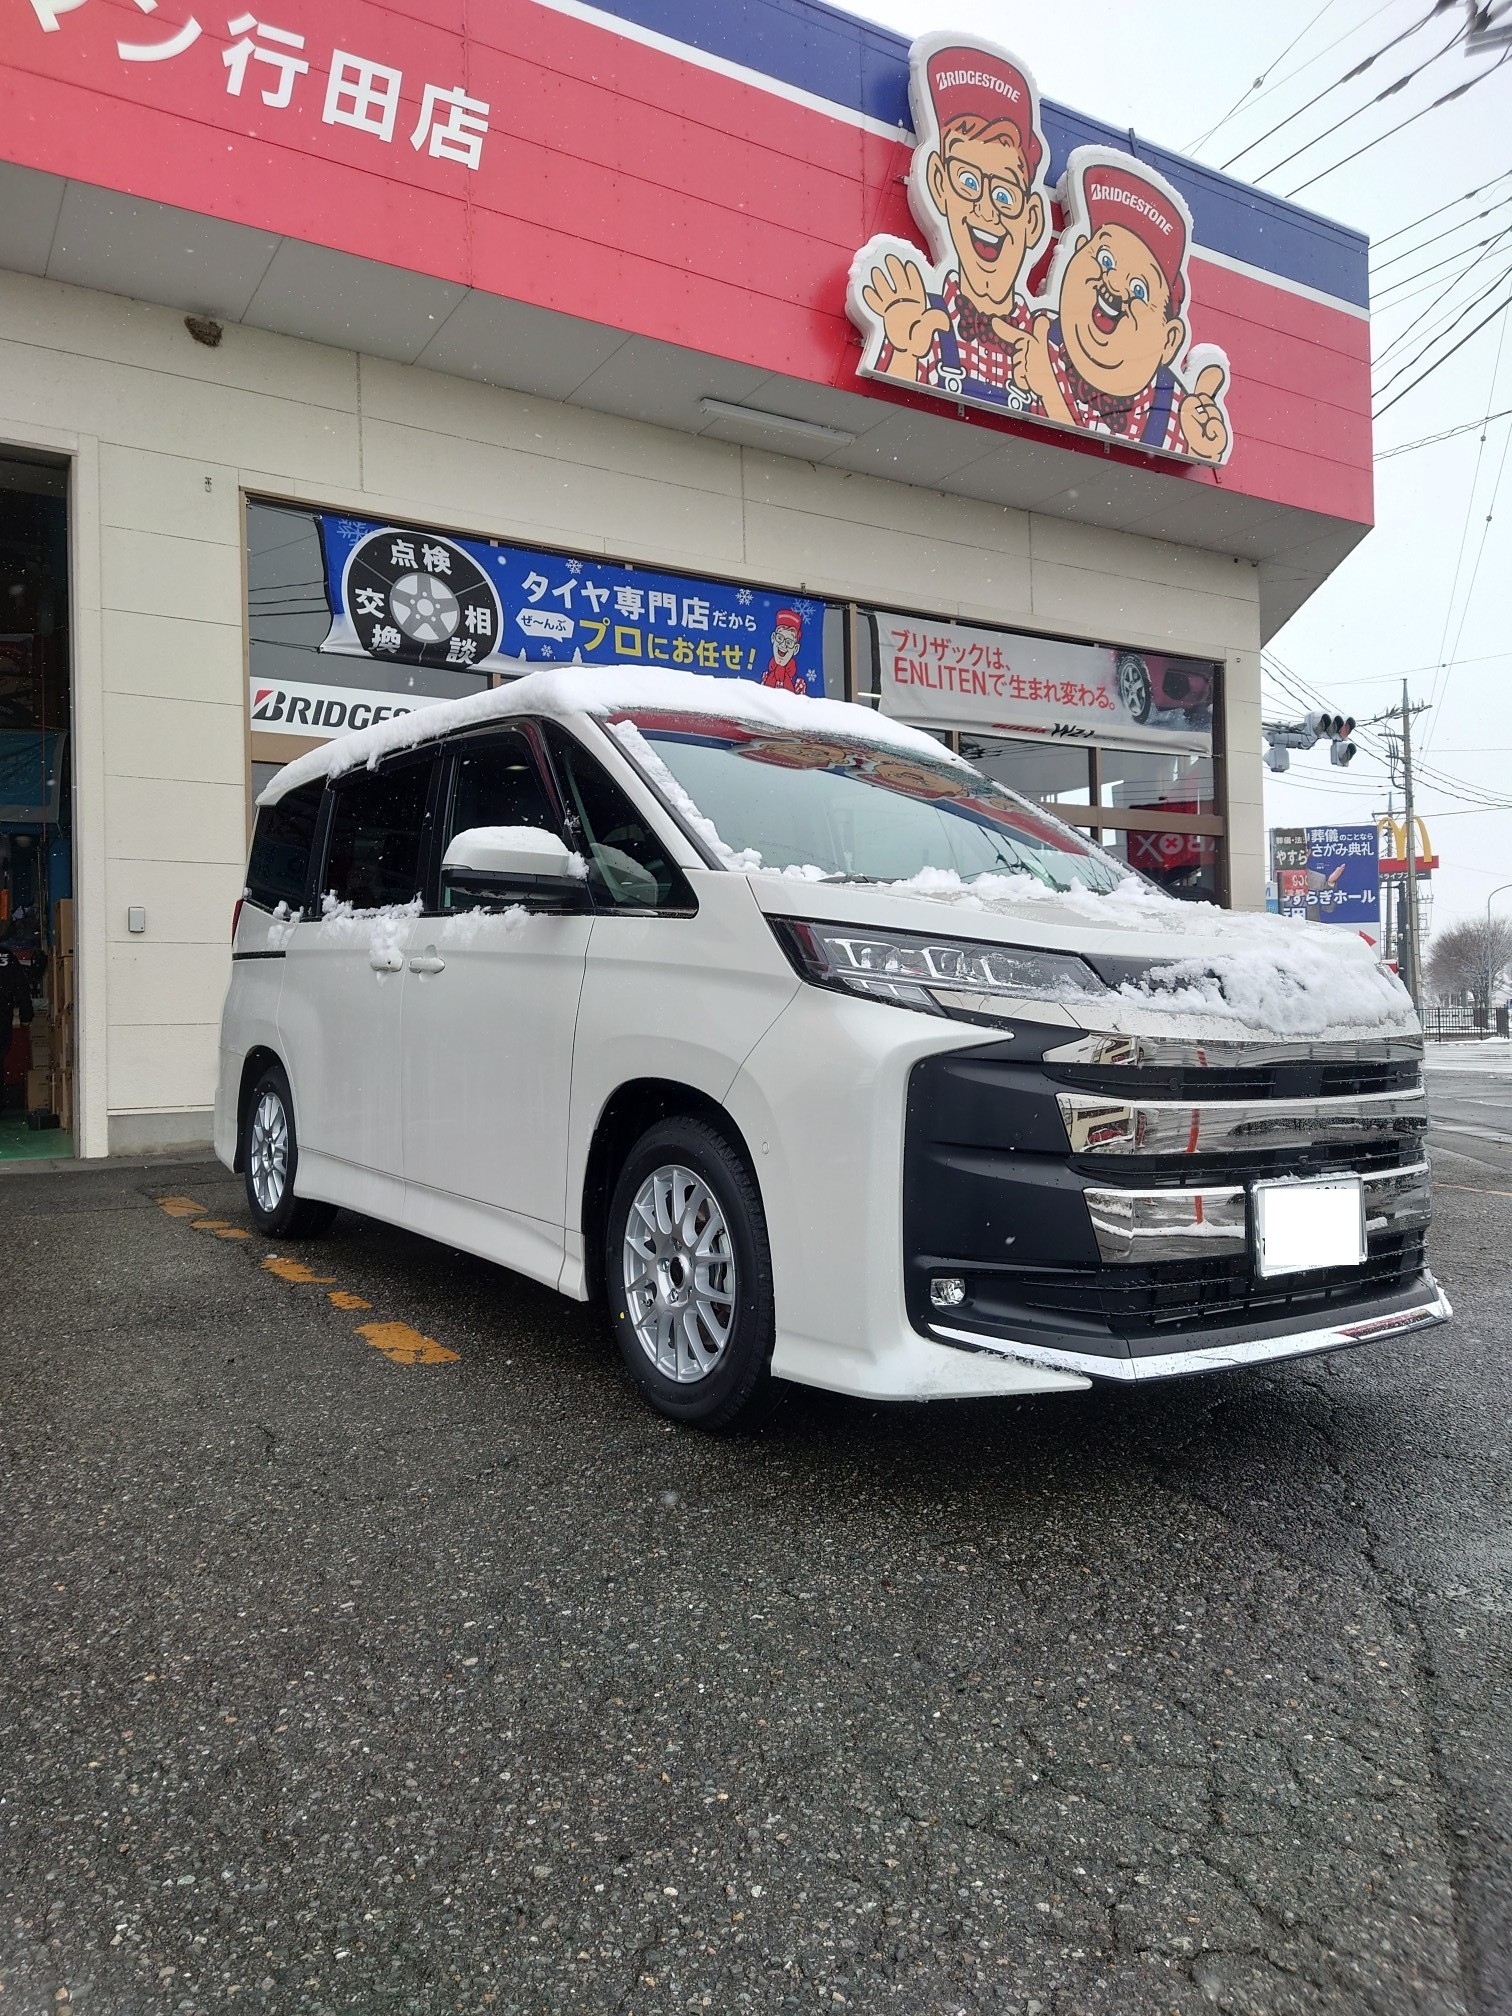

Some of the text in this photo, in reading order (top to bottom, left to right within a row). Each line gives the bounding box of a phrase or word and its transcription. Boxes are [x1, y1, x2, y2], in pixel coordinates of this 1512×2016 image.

[936, 69, 1021, 103] BRIDGESTONE
[1090, 183, 1174, 236] BRIDGESTONE
[390, 539, 452, 575] 点検
[354, 587, 401, 654] 交換
[520, 571, 757, 631] タイヤ専門店だから
[445, 604, 492, 664] 相談
[890, 630, 1012, 672] ブリザックは、
[1310, 828, 1374, 843] 葬儀のことなら
[1311, 842, 1375, 858] さがみ典礼
